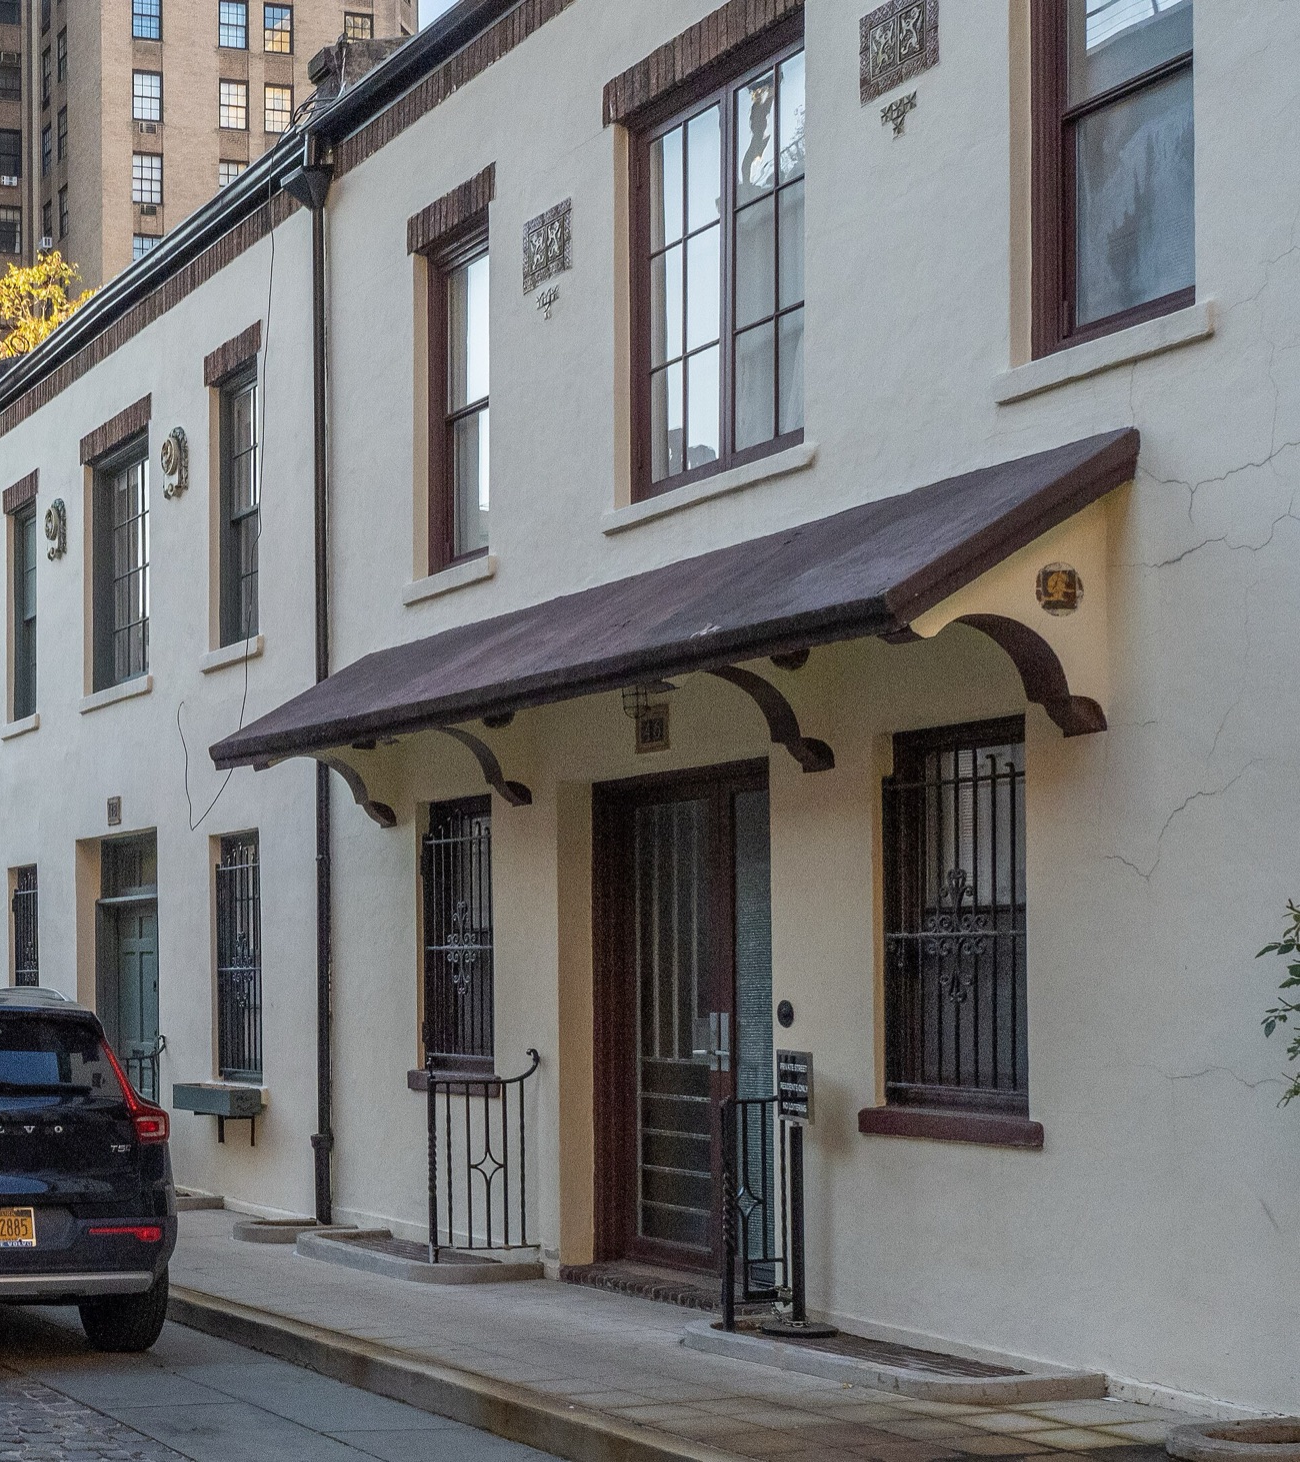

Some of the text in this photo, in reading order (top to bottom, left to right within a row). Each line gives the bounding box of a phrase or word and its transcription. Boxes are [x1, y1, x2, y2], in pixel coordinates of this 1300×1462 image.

[780, 1063, 807, 1072] PRIVATE STREET
[780, 1082, 798, 1092] RESIDENTS
[783, 1102, 807, 1112] NO LOITERING
